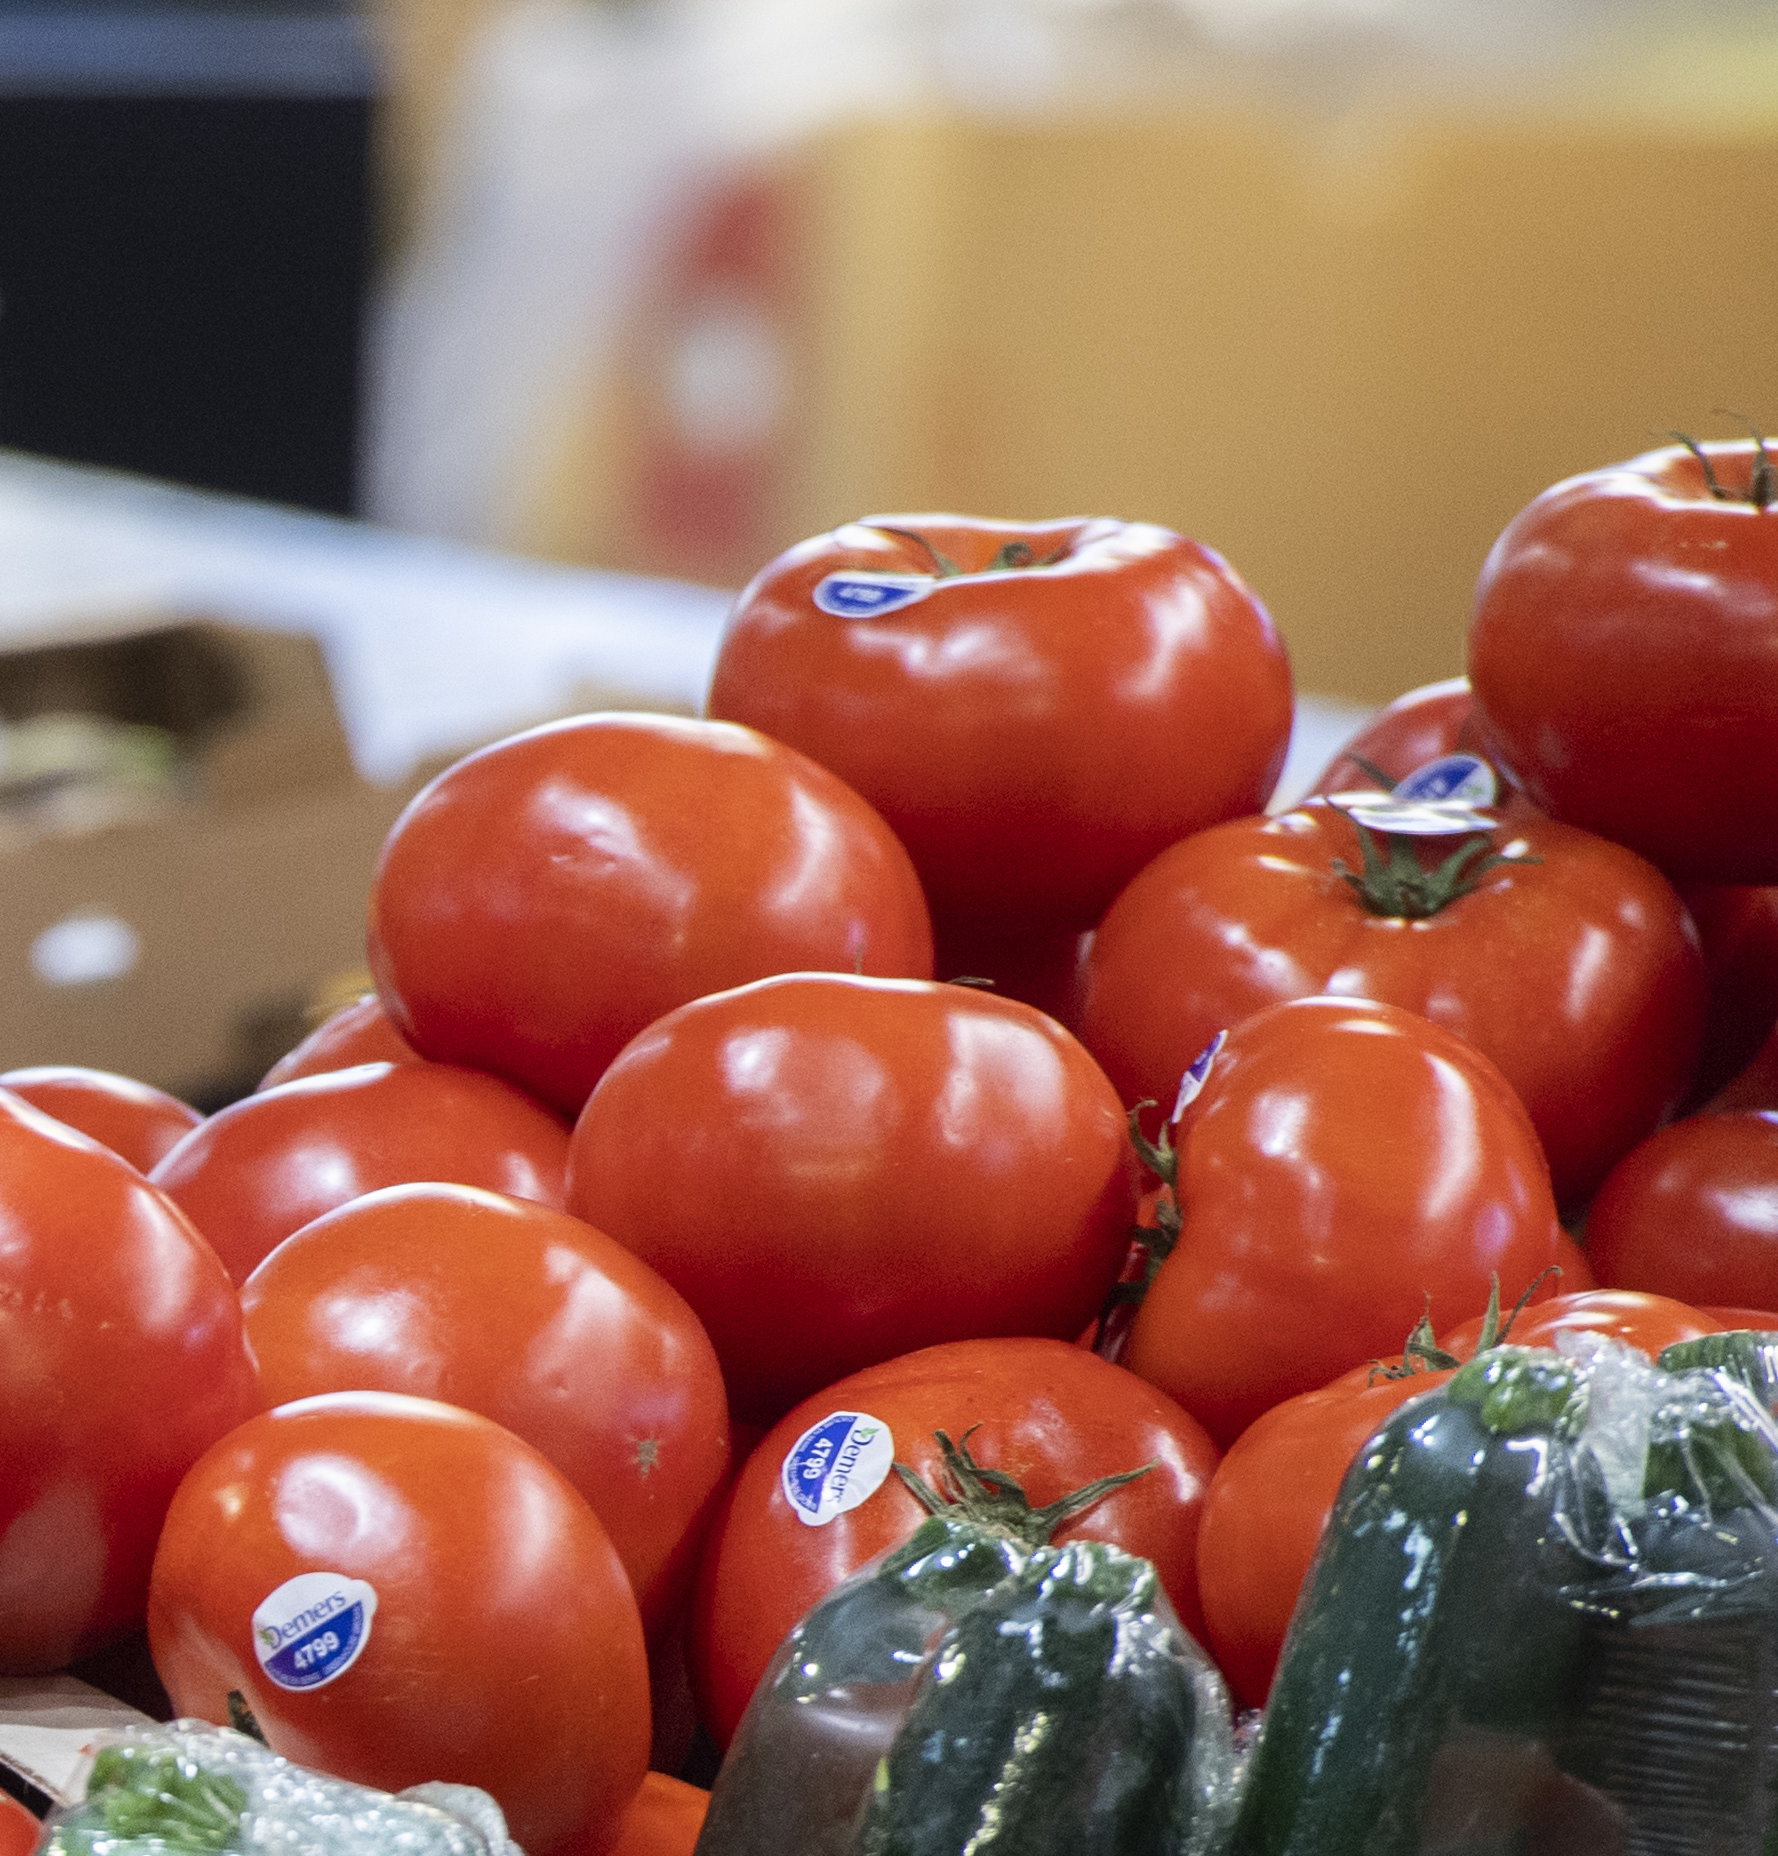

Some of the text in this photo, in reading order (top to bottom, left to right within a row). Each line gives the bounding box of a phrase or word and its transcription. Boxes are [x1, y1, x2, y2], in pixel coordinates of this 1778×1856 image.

[803, 1437, 834, 1480] 4799
[829, 1429, 877, 1503] Demers
[260, 1590, 346, 1649] Demers
[294, 1631, 341, 1669] 4799
